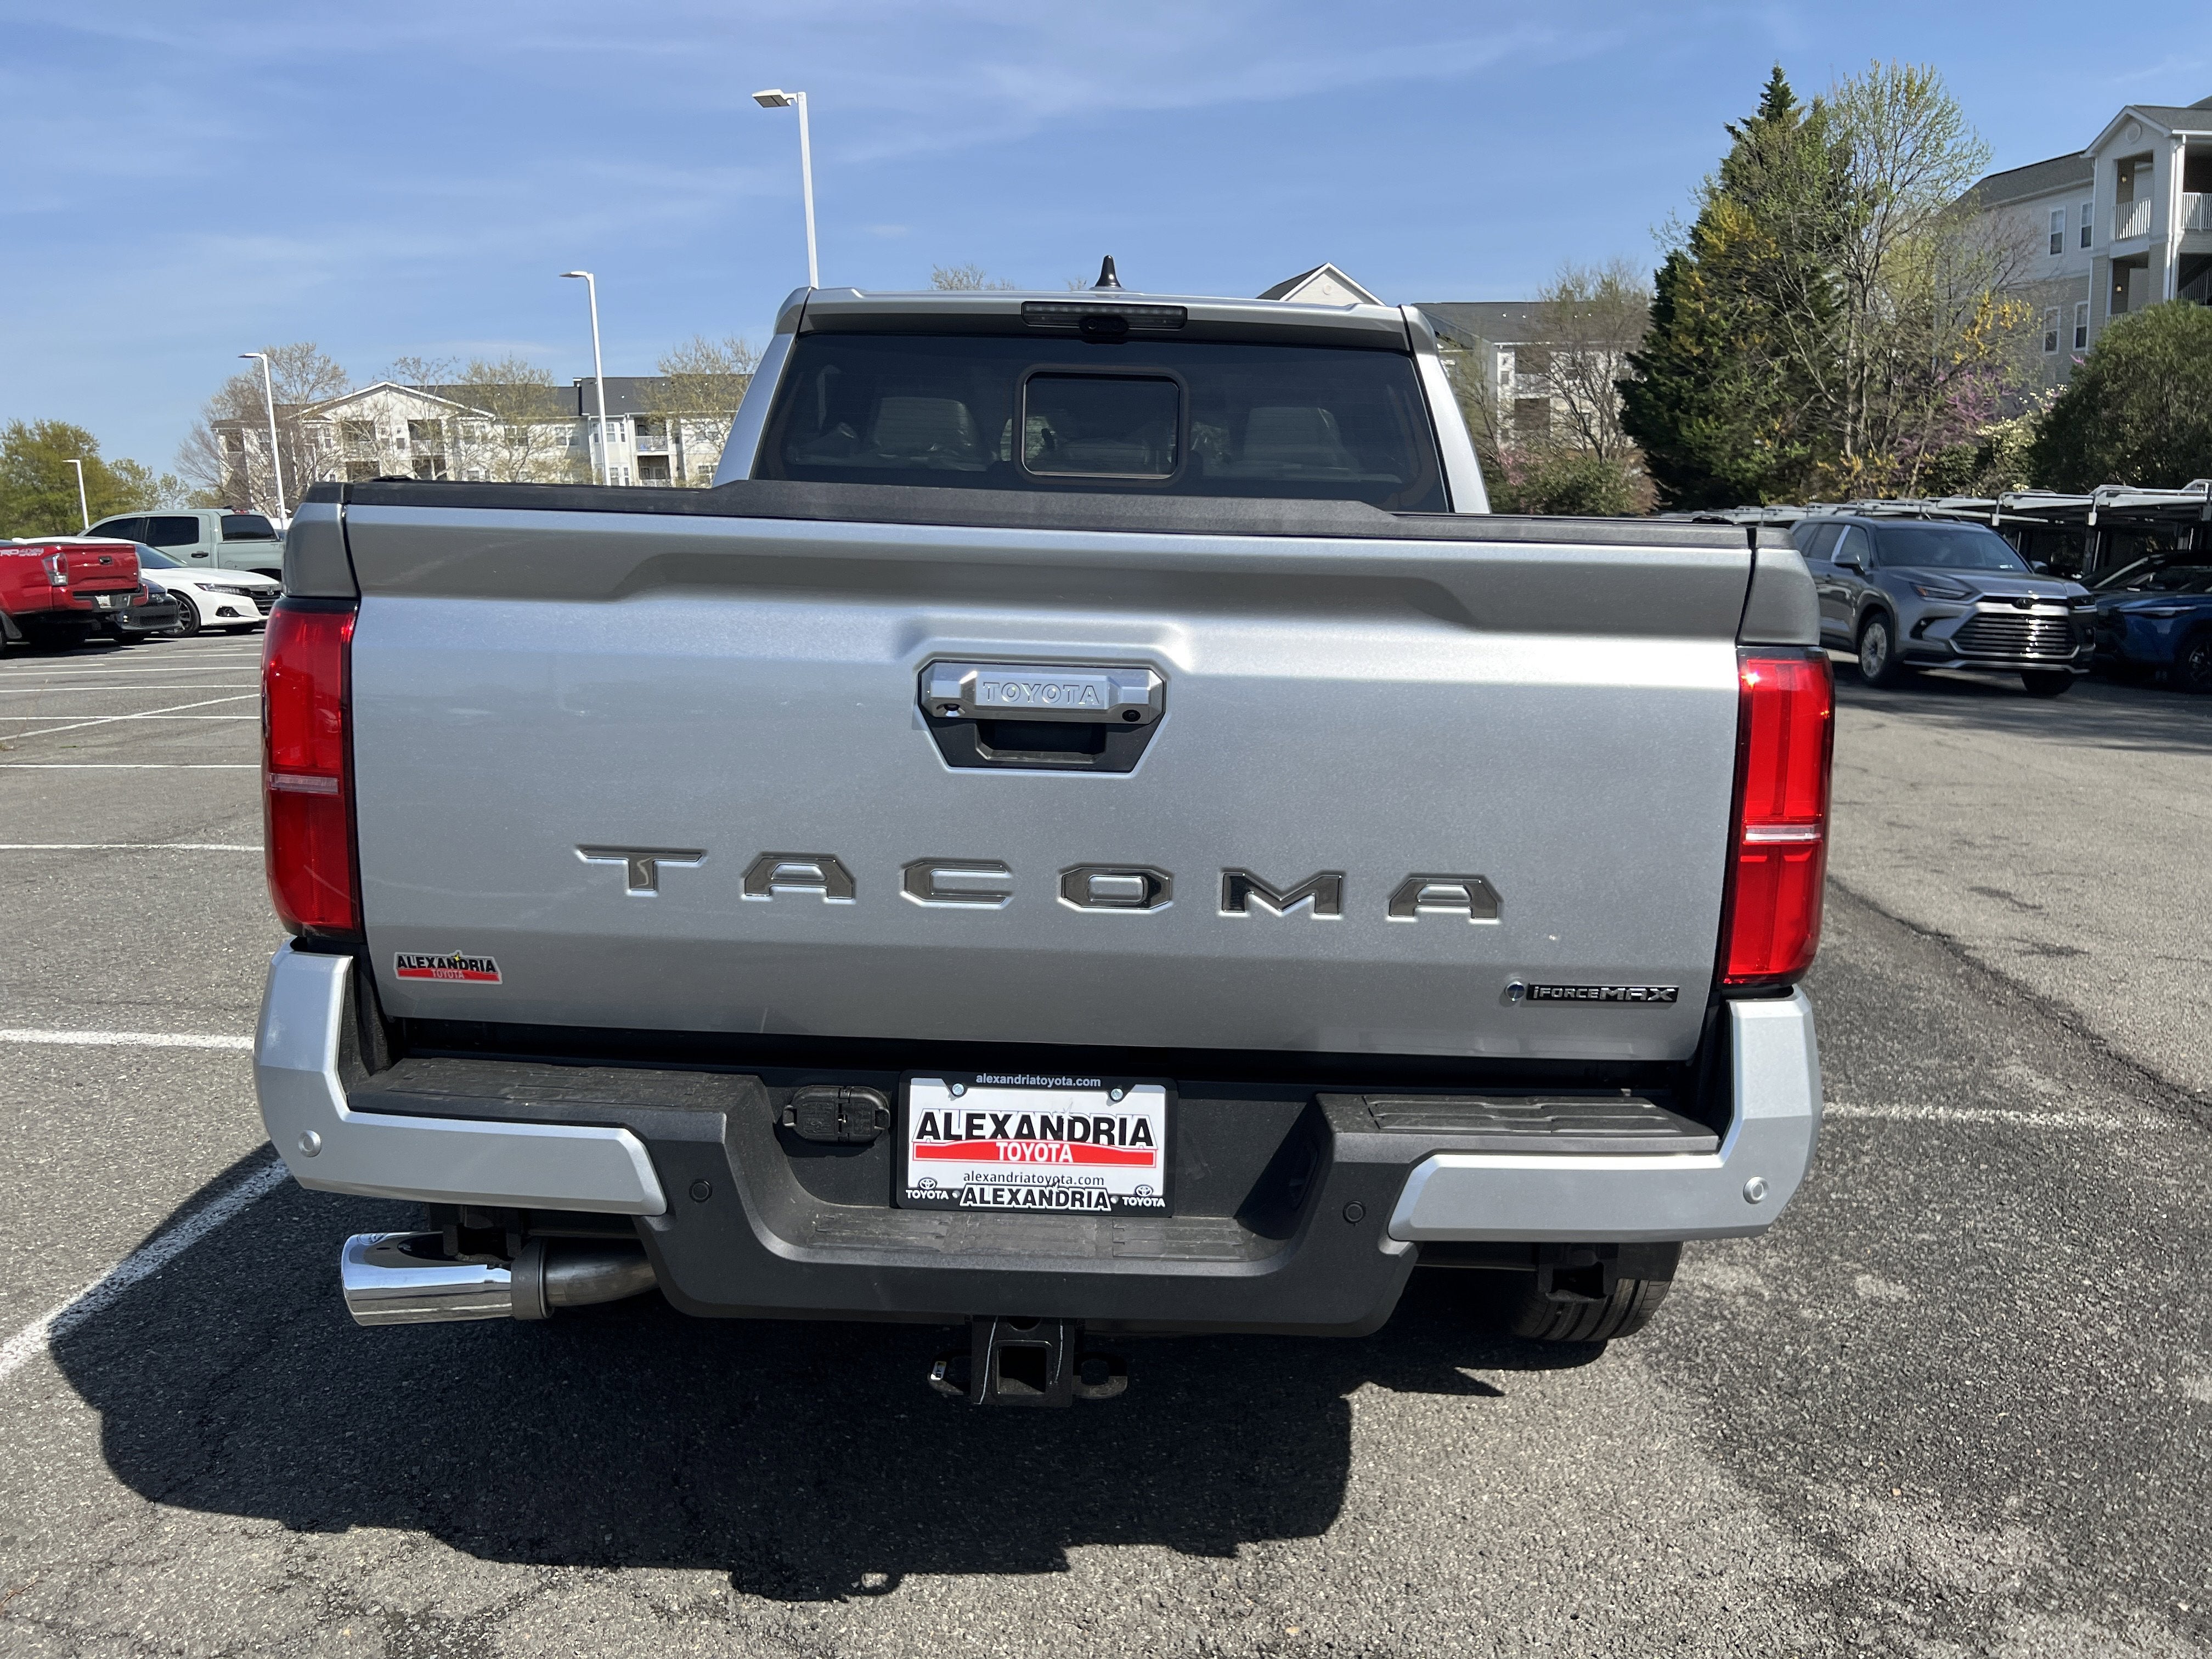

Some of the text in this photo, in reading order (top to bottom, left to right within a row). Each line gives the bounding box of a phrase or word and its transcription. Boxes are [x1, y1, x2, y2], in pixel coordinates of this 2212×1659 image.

[983, 682, 1099, 706] TOYOTA
[576, 845, 1502, 923] TACOMA
[397, 955, 496, 973] ALEXANDRIA
[431, 969, 465, 979] TOYOTA
[975, 1073, 1101, 1087] alexandriatoyota.com
[916, 1111, 1154, 1147] ALEXANDRIA
[996, 1142, 1073, 1163] TOYOTA
[963, 1171, 1104, 1187] alexandriatoyota.com
[906, 1189, 949, 1200] TOYOTA
[962, 1187, 1110, 1210] ALEXANDRIA
[1122, 1196, 1165, 1207] TOYOTA
